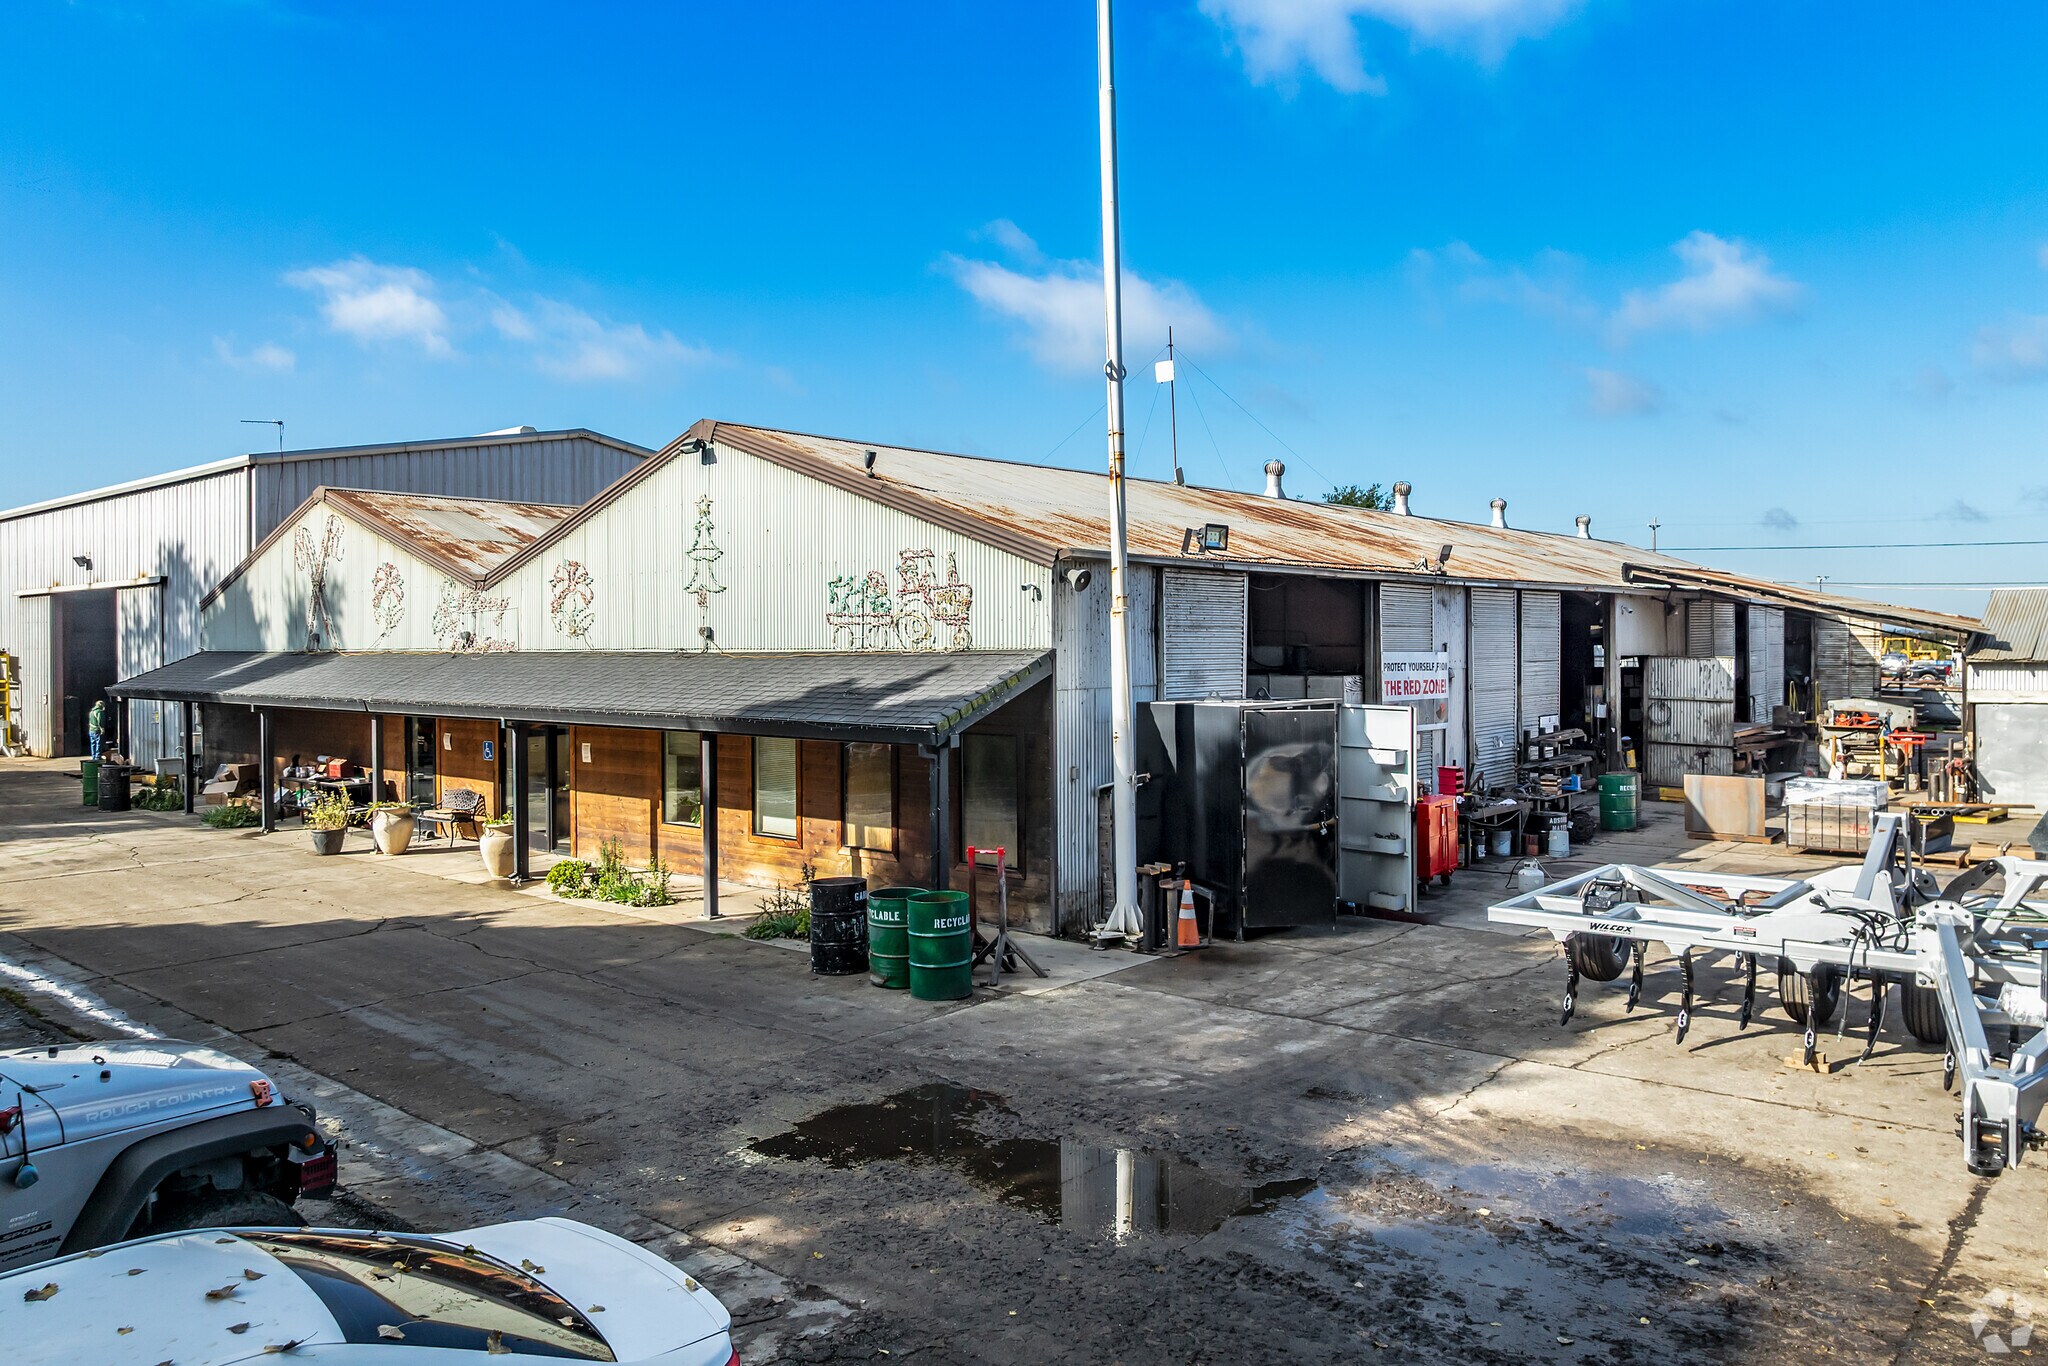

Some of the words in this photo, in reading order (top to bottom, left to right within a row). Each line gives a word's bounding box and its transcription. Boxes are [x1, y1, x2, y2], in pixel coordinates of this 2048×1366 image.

[1384, 662, 1406, 671] PROTECT
[1408, 662, 1435, 671] YOURSELF
[1384, 680, 1402, 696] THE
[1403, 679, 1421, 695] RED
[1423, 678, 1447, 694] ZONE!
[1590, 922, 1633, 933] WILCOX
[86, 1101, 150, 1123] ROUGH
[156, 1085, 236, 1108] COUNTRY
[2, 1222, 48, 1240] SPORT
